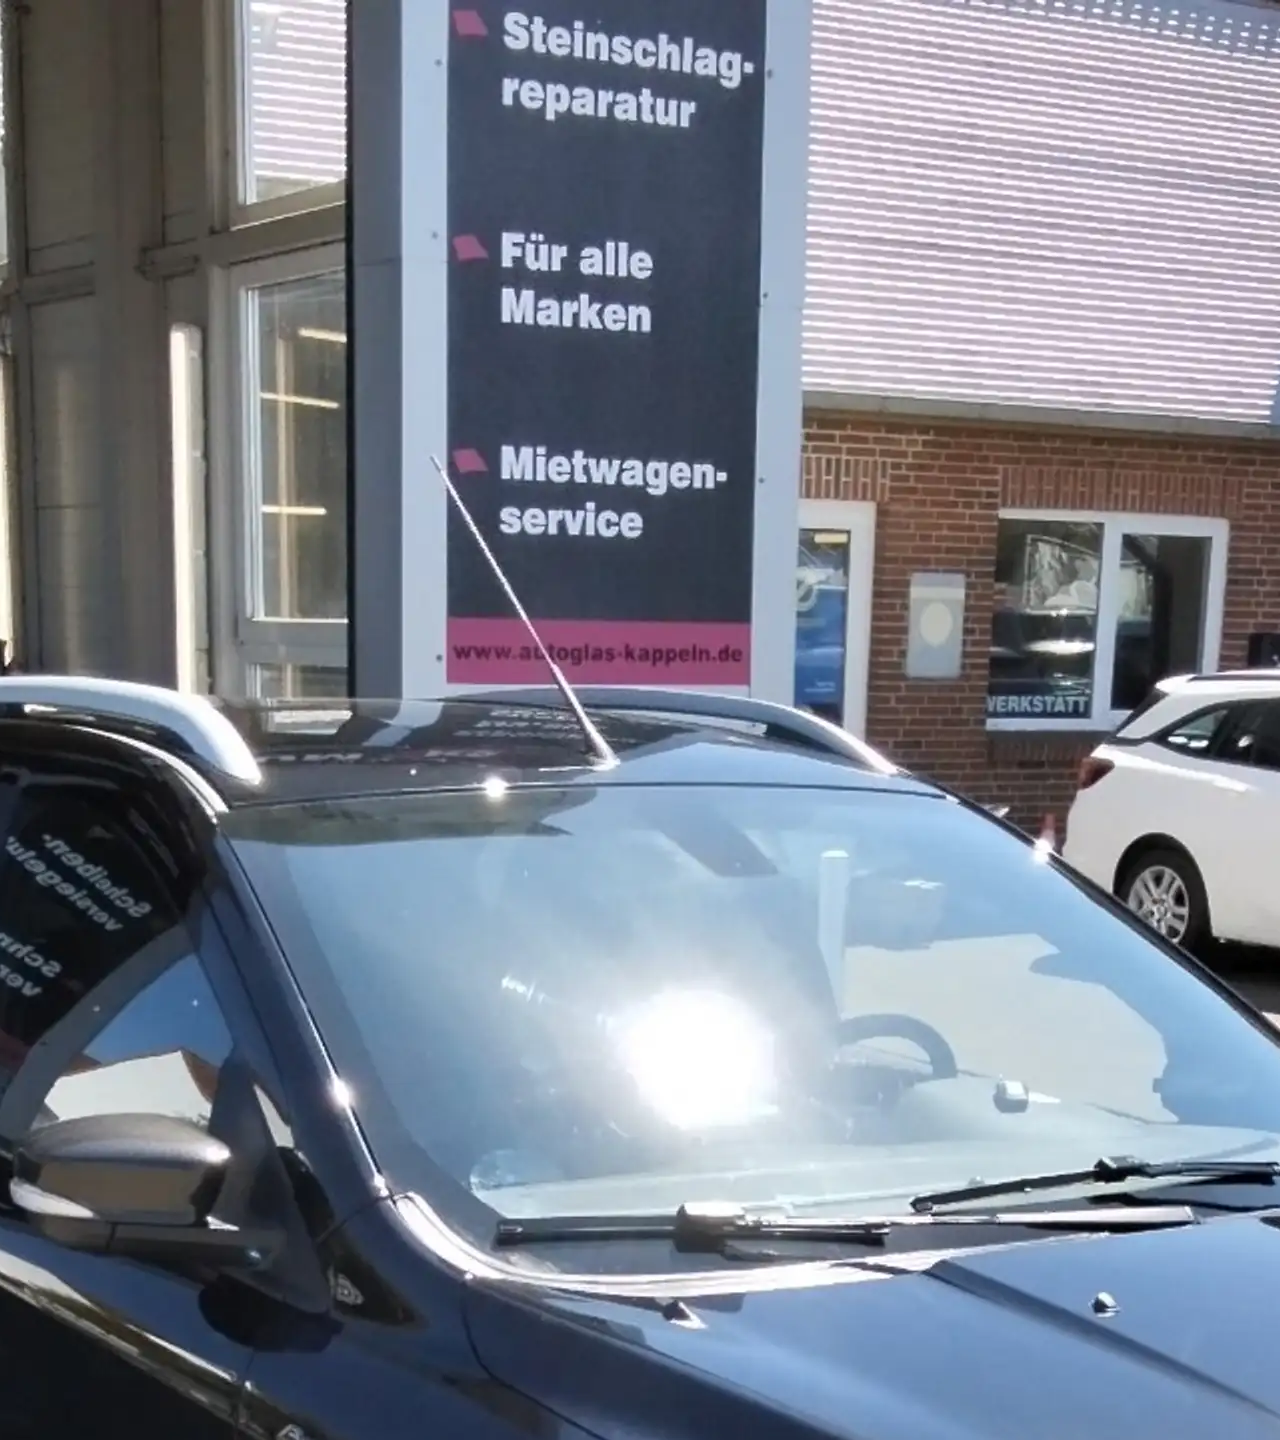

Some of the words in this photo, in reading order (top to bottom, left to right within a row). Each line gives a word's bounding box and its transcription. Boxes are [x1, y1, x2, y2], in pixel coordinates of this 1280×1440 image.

[502, 11, 755, 88] Steinschlag-
[501, 76, 697, 128] reparatur
[501, 232, 568, 272] Für
[579, 241, 654, 279] alle
[500, 287, 652, 333] Marken
[500, 444, 728, 496] Mietwagen-
[499, 501, 644, 538] service
[452, 643, 743, 667] www.autoglas-kappeln.de
